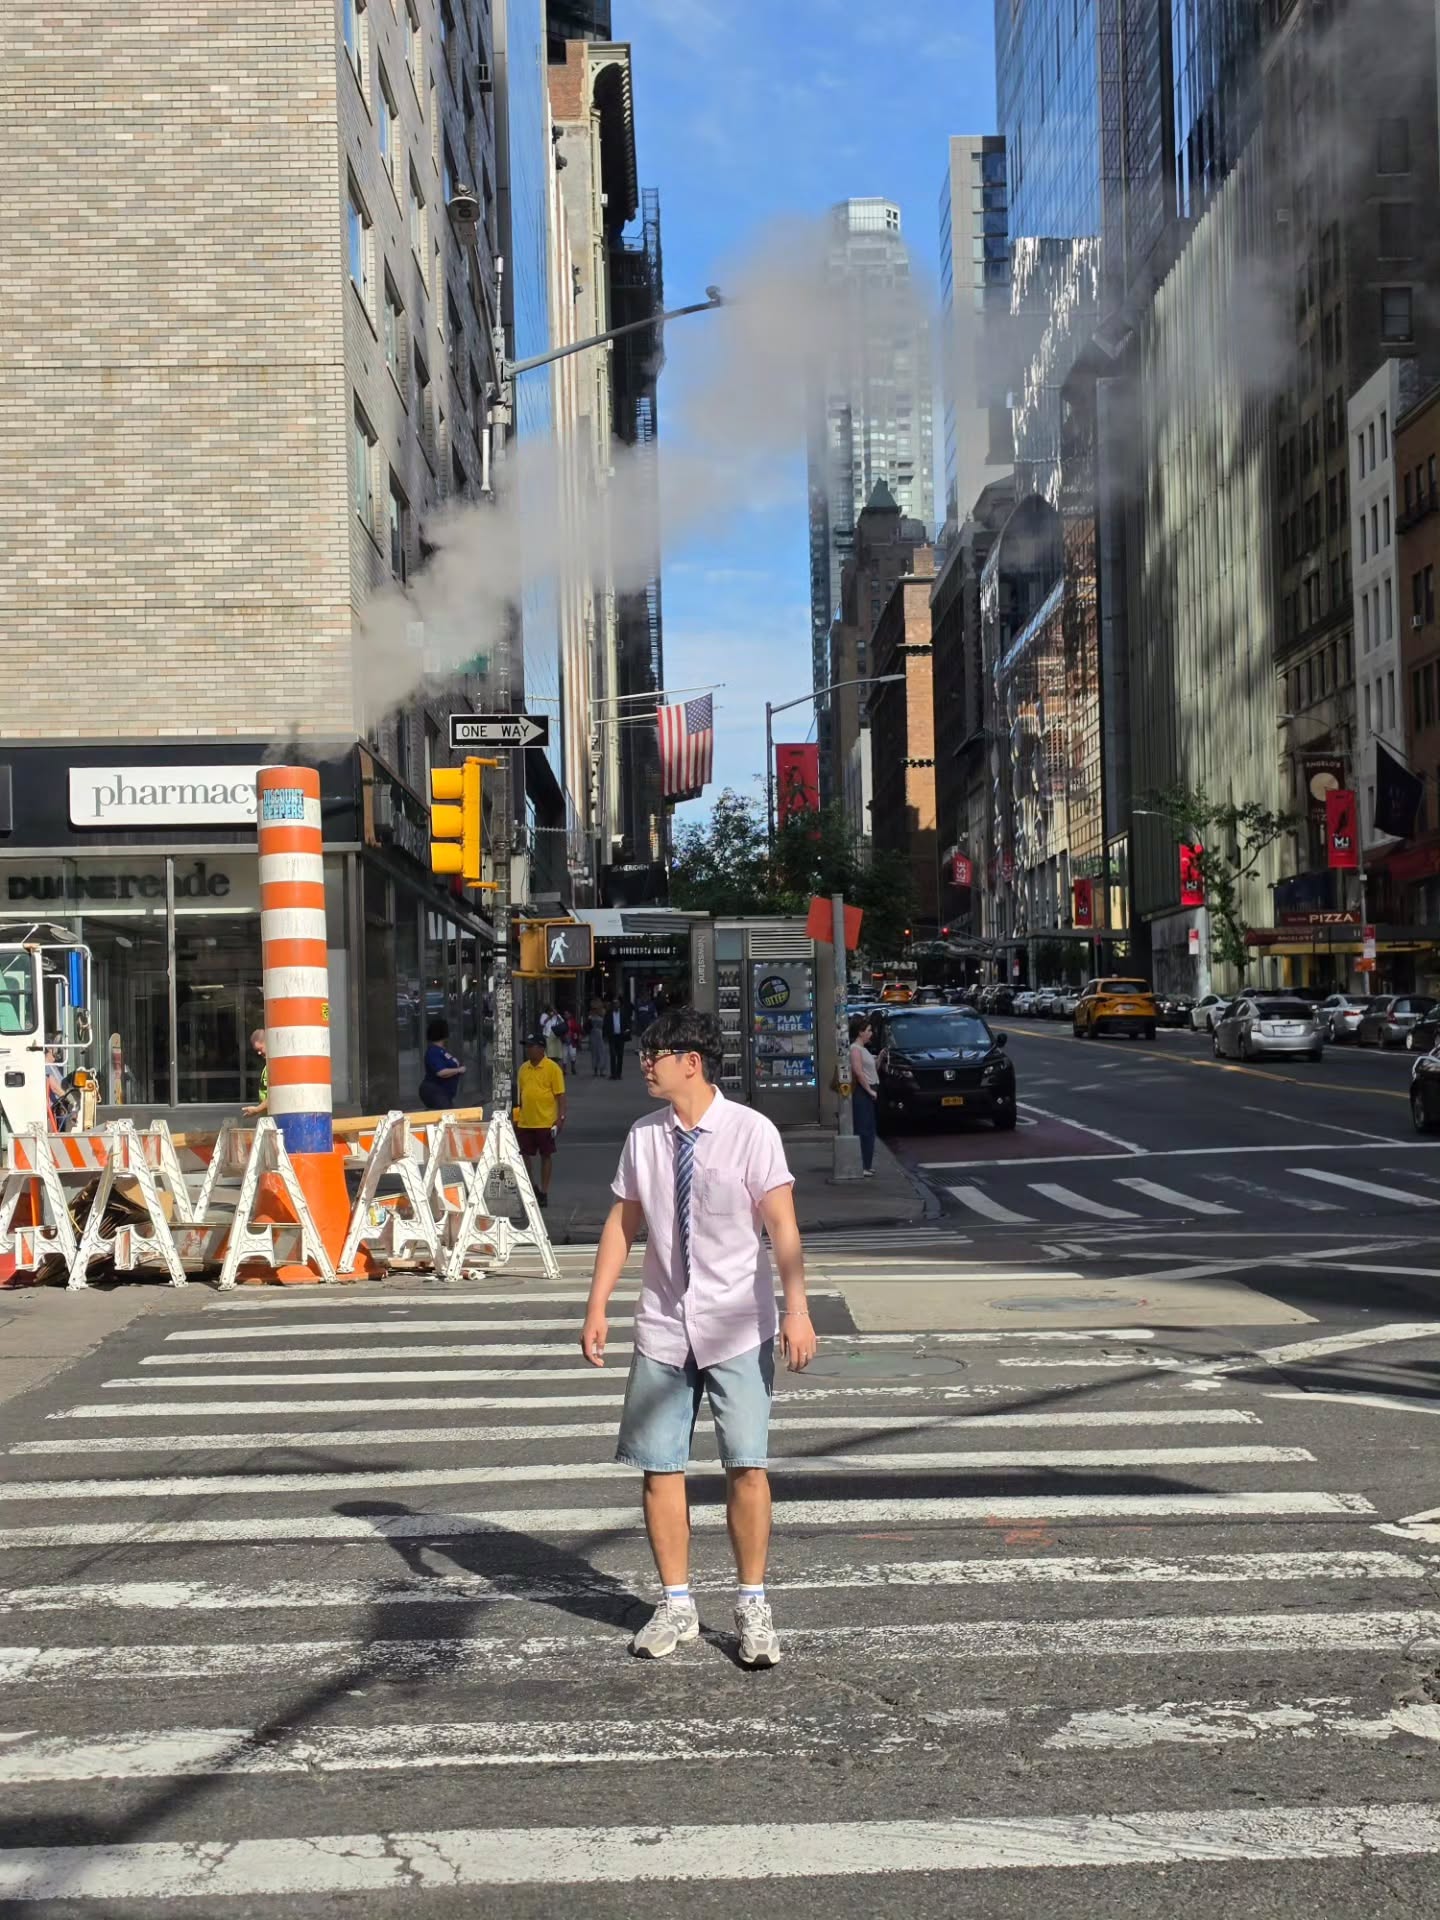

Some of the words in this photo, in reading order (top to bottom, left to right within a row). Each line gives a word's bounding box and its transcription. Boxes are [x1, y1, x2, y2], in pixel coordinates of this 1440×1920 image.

[461, 725, 488, 737] ONE
[501, 725, 529, 737] WAY
[91, 774, 258, 817] pharmacy
[1309, 913, 1354, 923] PIZZA
[697, 935, 707, 984] Newsstand
[777, 1015, 801, 1024] PLAY
[777, 1023, 803, 1032] HERE
[785, 1060, 804, 1068] LAY
